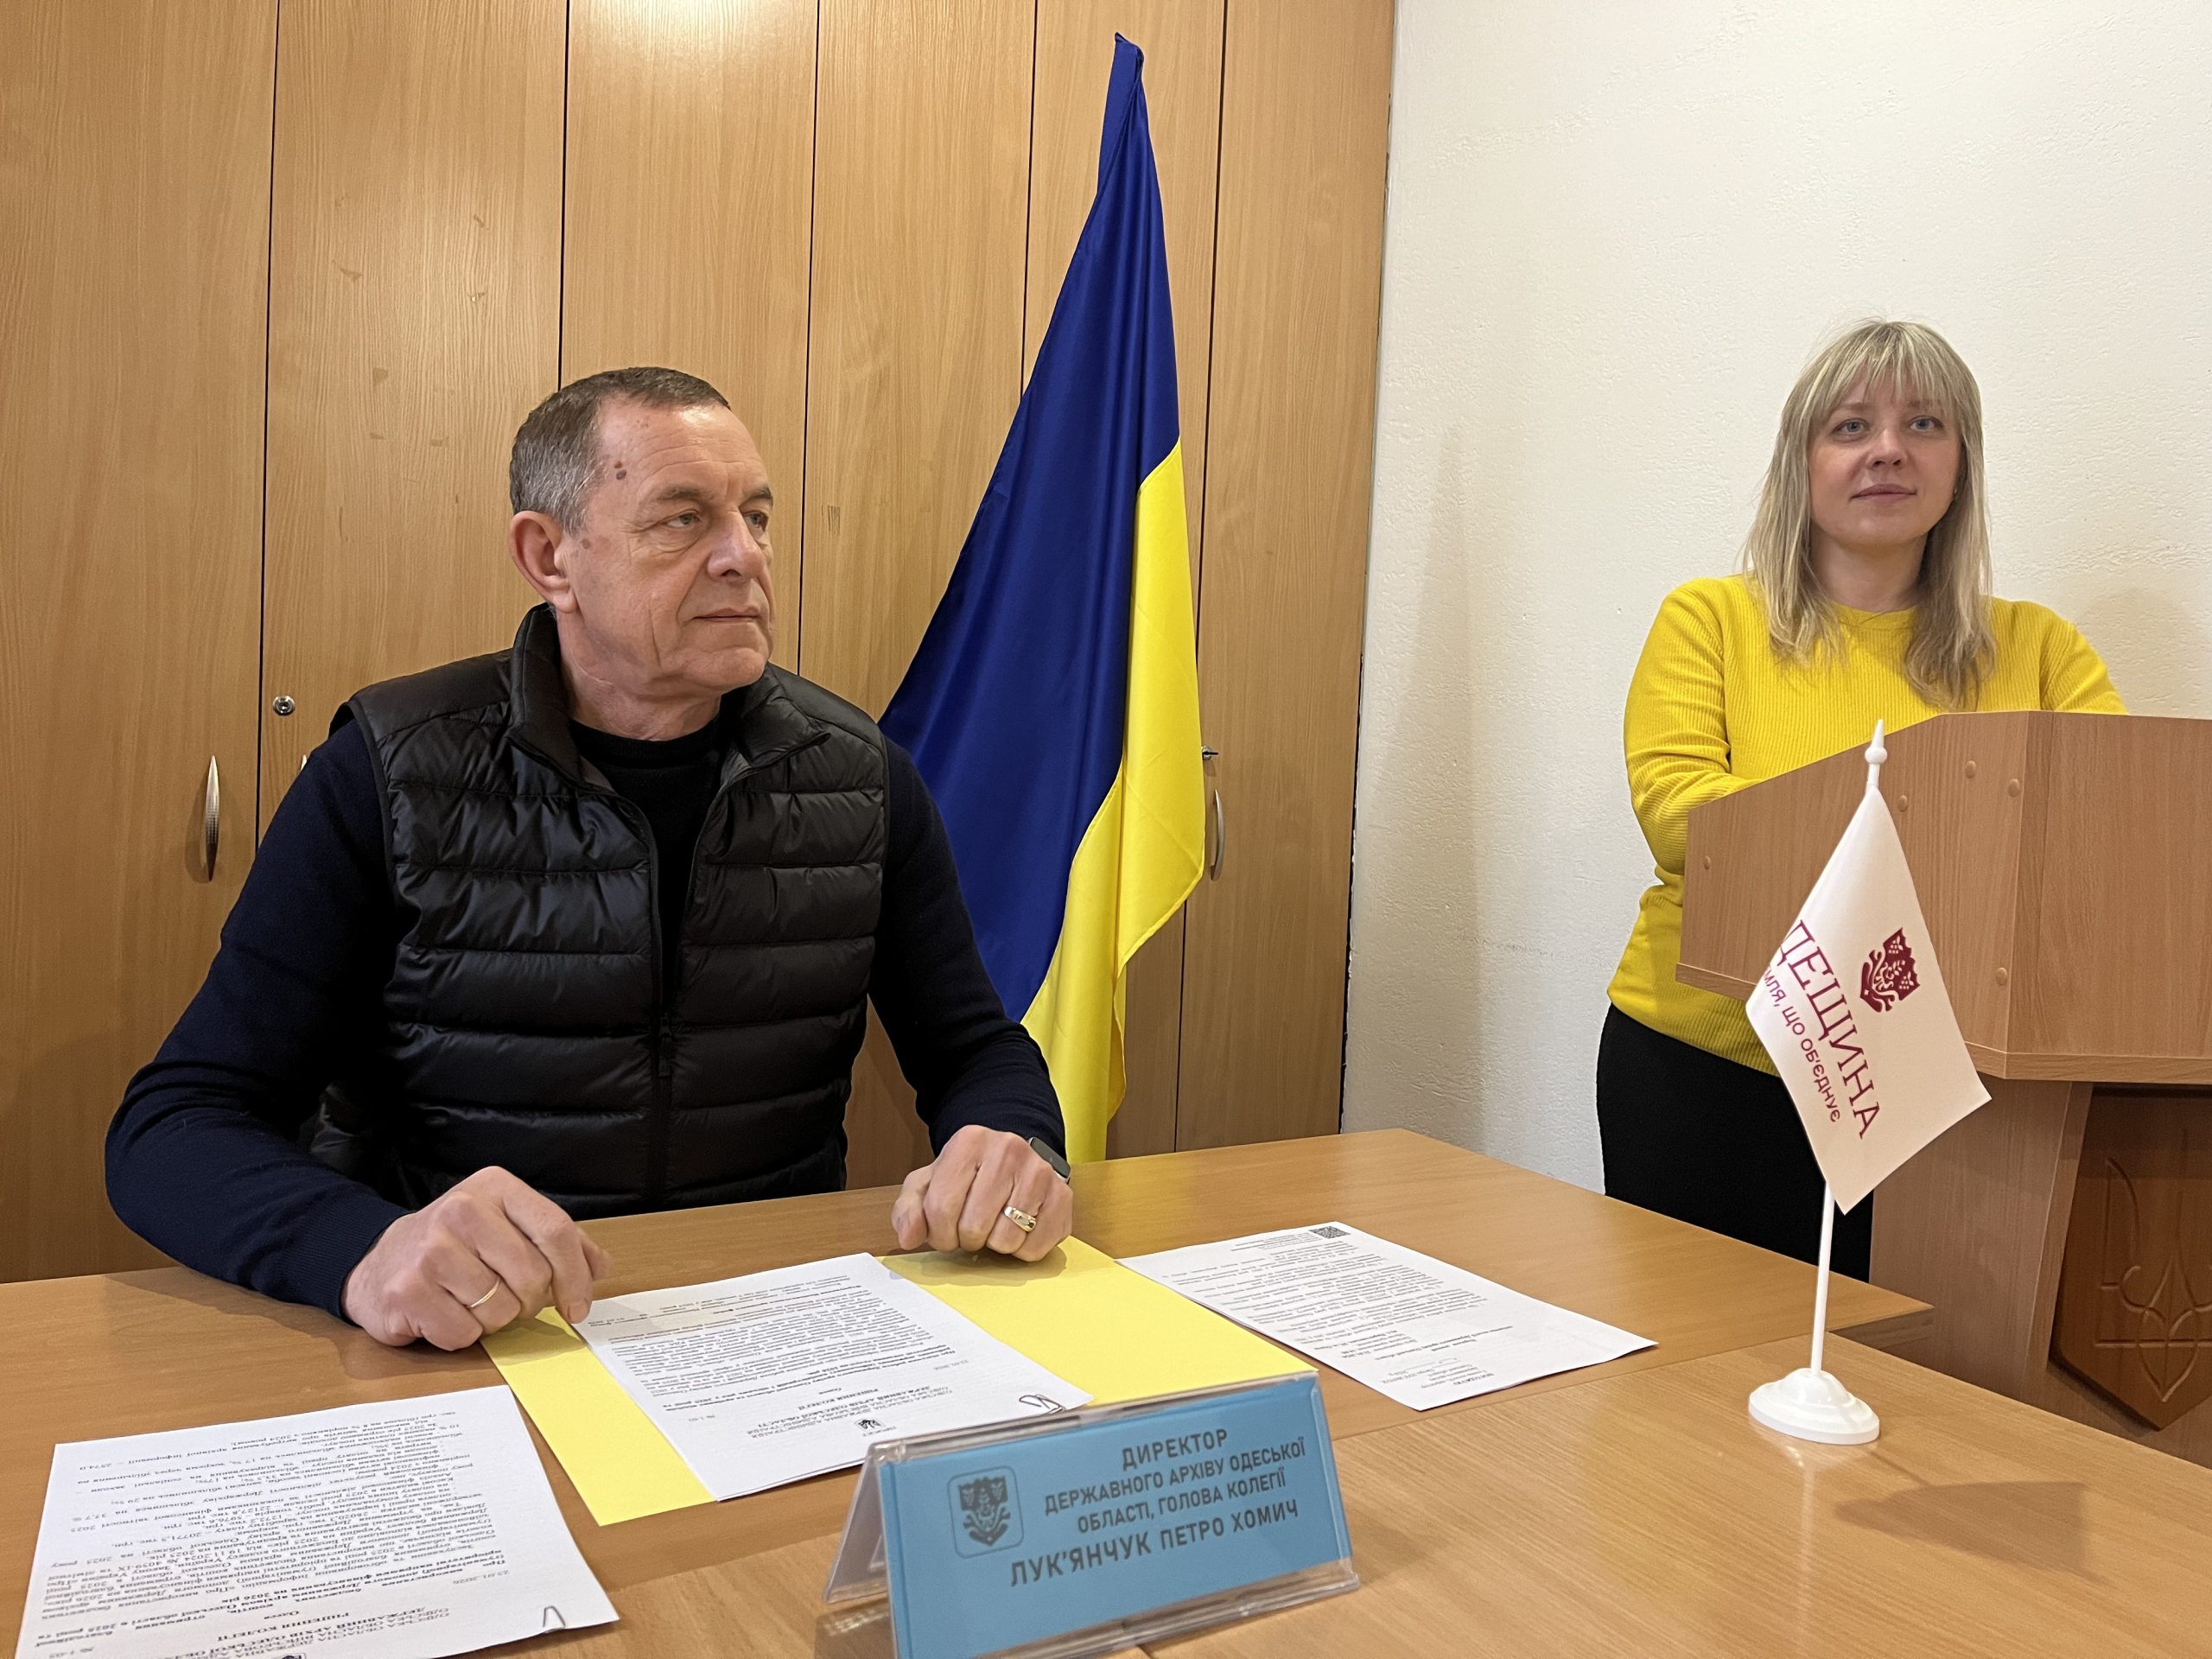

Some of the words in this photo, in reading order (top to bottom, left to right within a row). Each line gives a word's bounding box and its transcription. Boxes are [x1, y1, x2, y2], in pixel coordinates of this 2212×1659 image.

[1782, 1006, 1805, 1035] ЩО
[1801, 1038, 1840, 1122] ОБ'ЄДНУЄ
[1045, 1471, 1164, 1516] ДЕРЖАВНОГО
[1169, 1459, 1225, 1488] АРХІВУ
[1230, 1436, 1306, 1473] ОДЕСЬКОЇ
[1122, 1428, 1228, 1471] ДИРЕКТОР
[1077, 1505, 1154, 1534] ОБЛАСТІ,
[1158, 1489, 1223, 1521] ГОЛОВА
[1227, 1467, 1287, 1499] КОЛЕГІЇ
[1010, 1531, 1152, 1587] ЛУК'ЯНЧУК
[1160, 1517, 1225, 1550] ПЕТРО
[1232, 1498, 1299, 1535] ХОМИЧ
